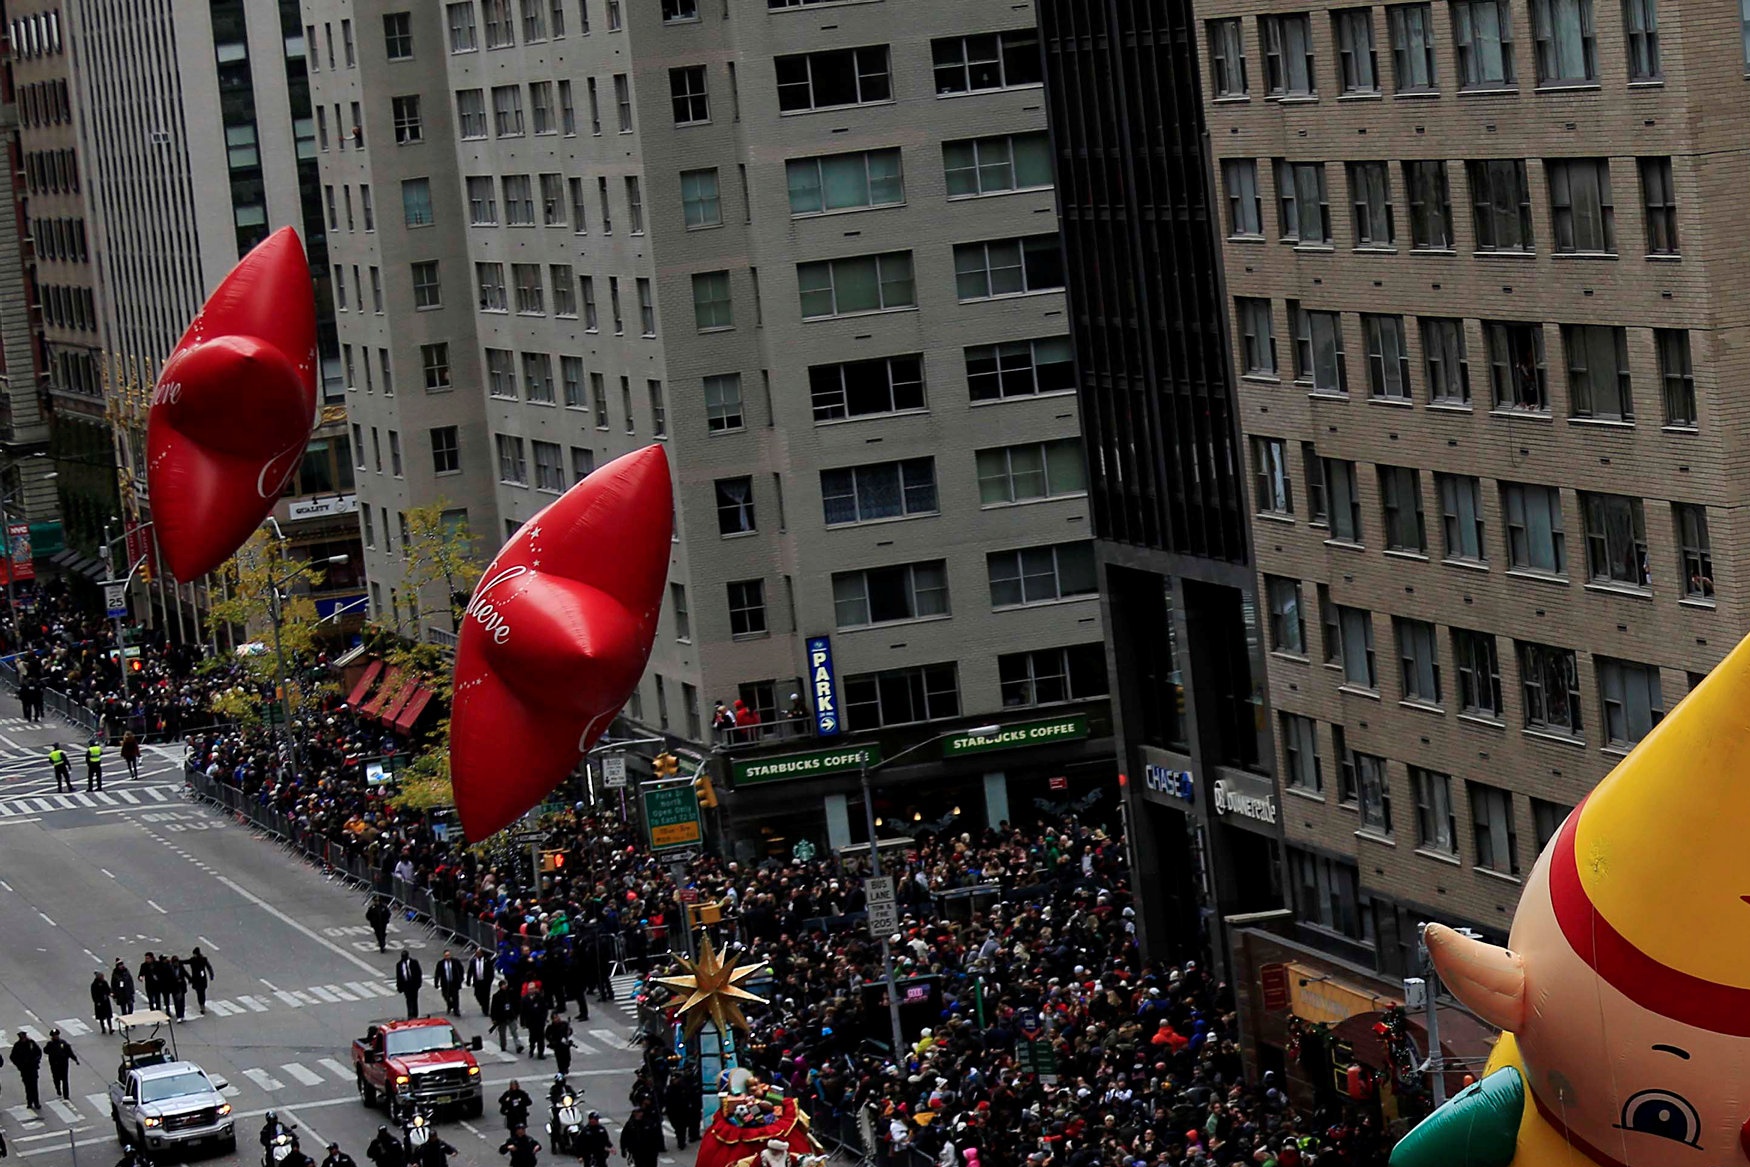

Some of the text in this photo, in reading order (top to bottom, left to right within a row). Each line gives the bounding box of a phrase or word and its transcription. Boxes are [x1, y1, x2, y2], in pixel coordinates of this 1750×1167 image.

[296, 504, 330, 514] QUALITY
[109, 598, 124, 608] 25
[813, 652, 834, 712] PARK
[1030, 723, 1076, 738] COFFEE
[746, 751, 870, 778] STARBUCKS COFFEE
[1145, 764, 1183, 798] CHASE
[871, 880, 887, 889] BUS
[871, 890, 892, 900] LANE
